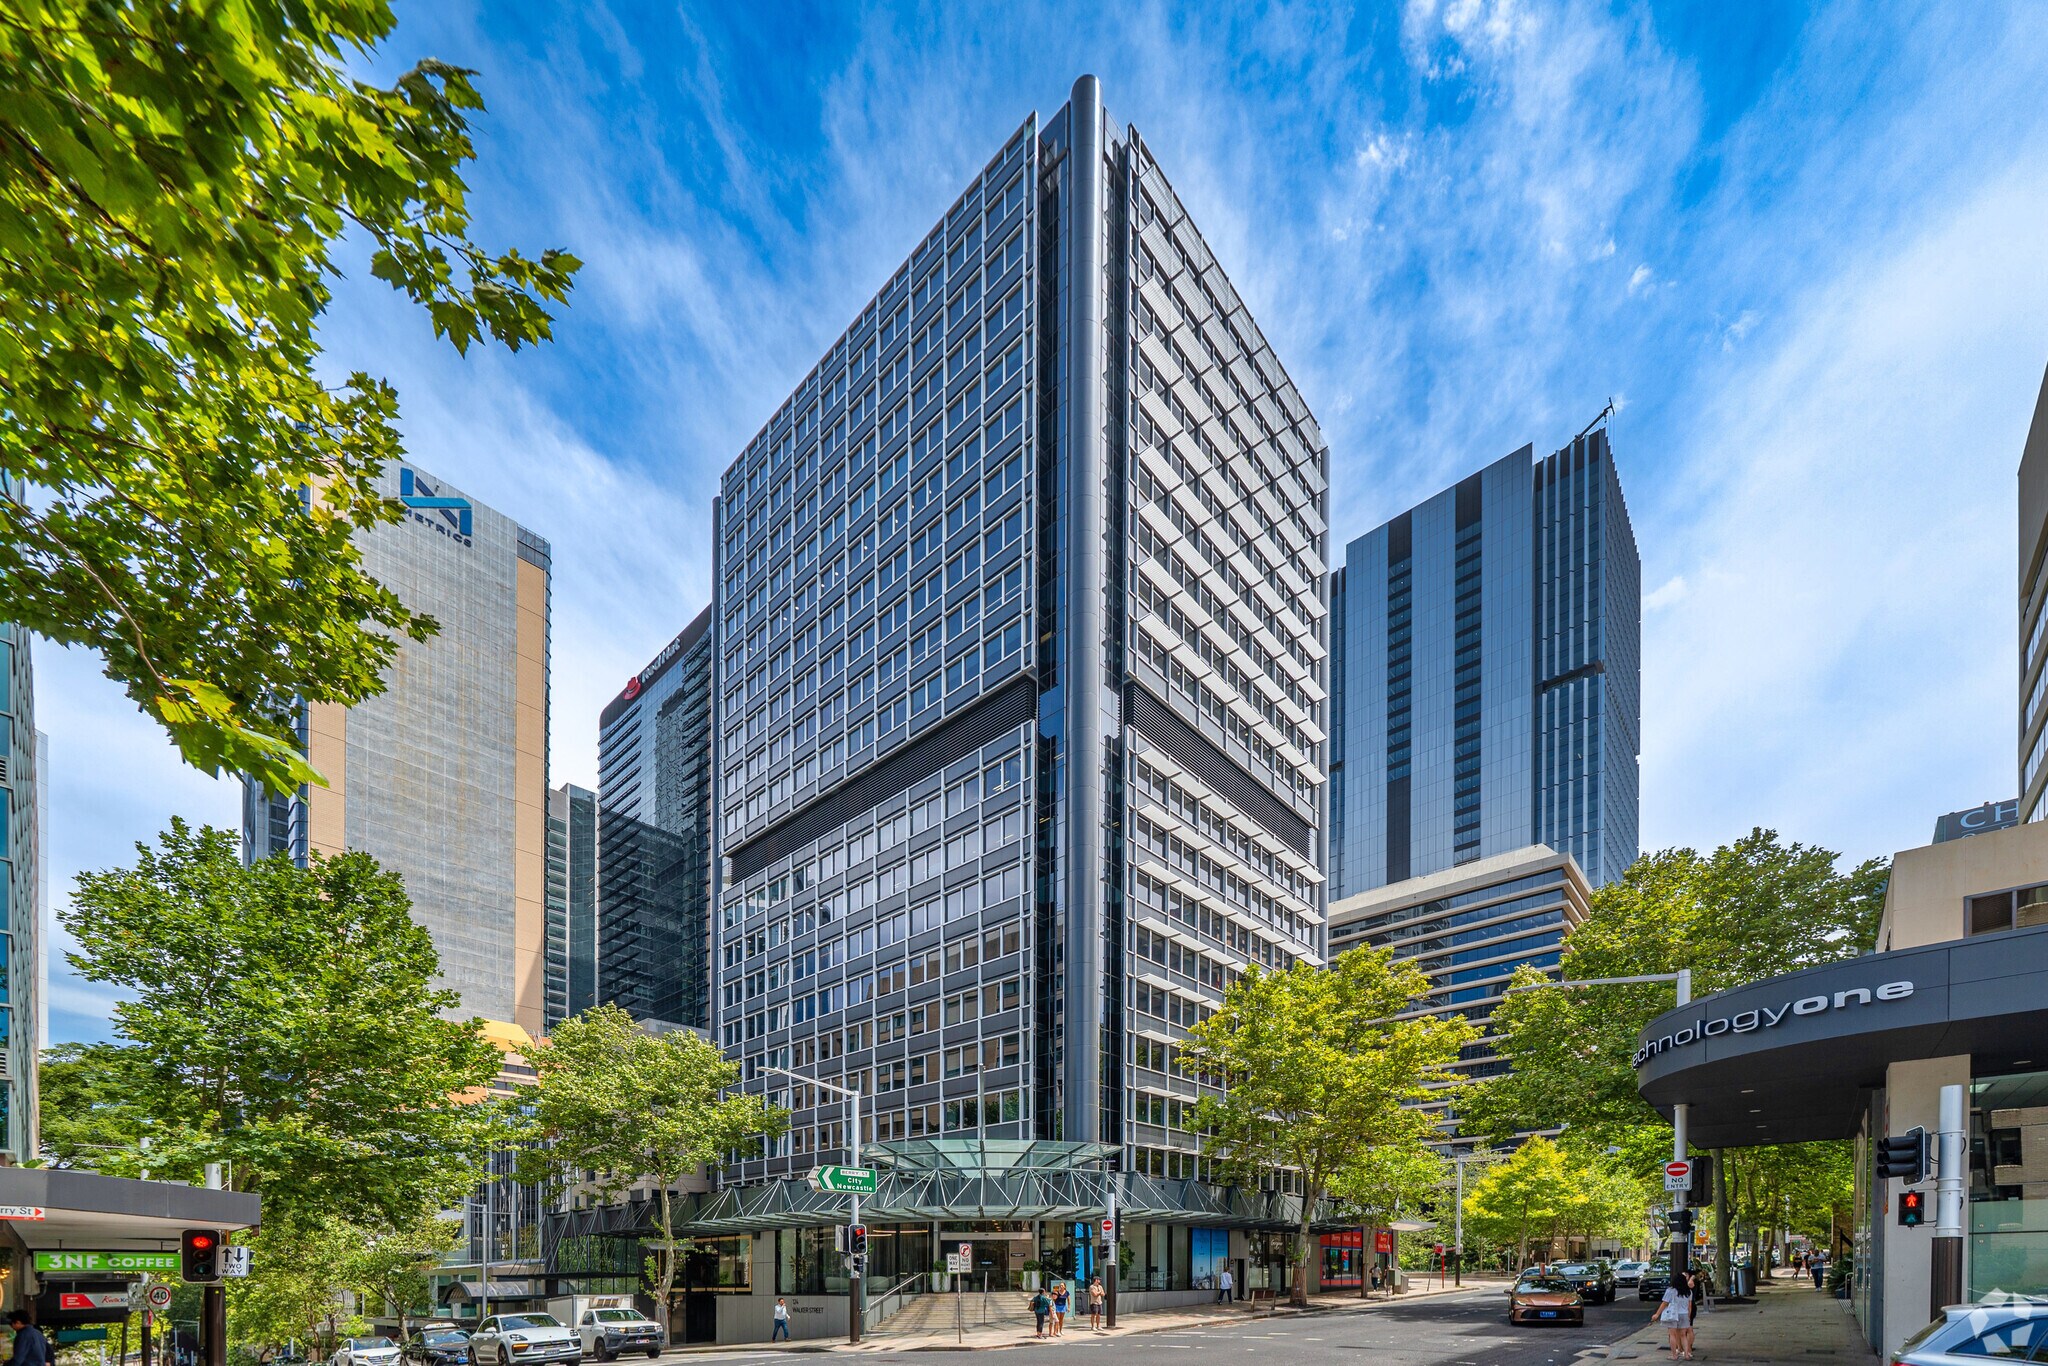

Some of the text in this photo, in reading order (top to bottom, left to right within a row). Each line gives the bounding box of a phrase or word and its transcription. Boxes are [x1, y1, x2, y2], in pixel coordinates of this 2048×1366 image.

[641, 655, 661, 683] Red
[1631, 981, 1914, 1070] echnologyone
[20, 1207, 31, 1215] St
[49, 1254, 174, 1269] 3NF COFFEE
[153, 1291, 167, 1300] 40
